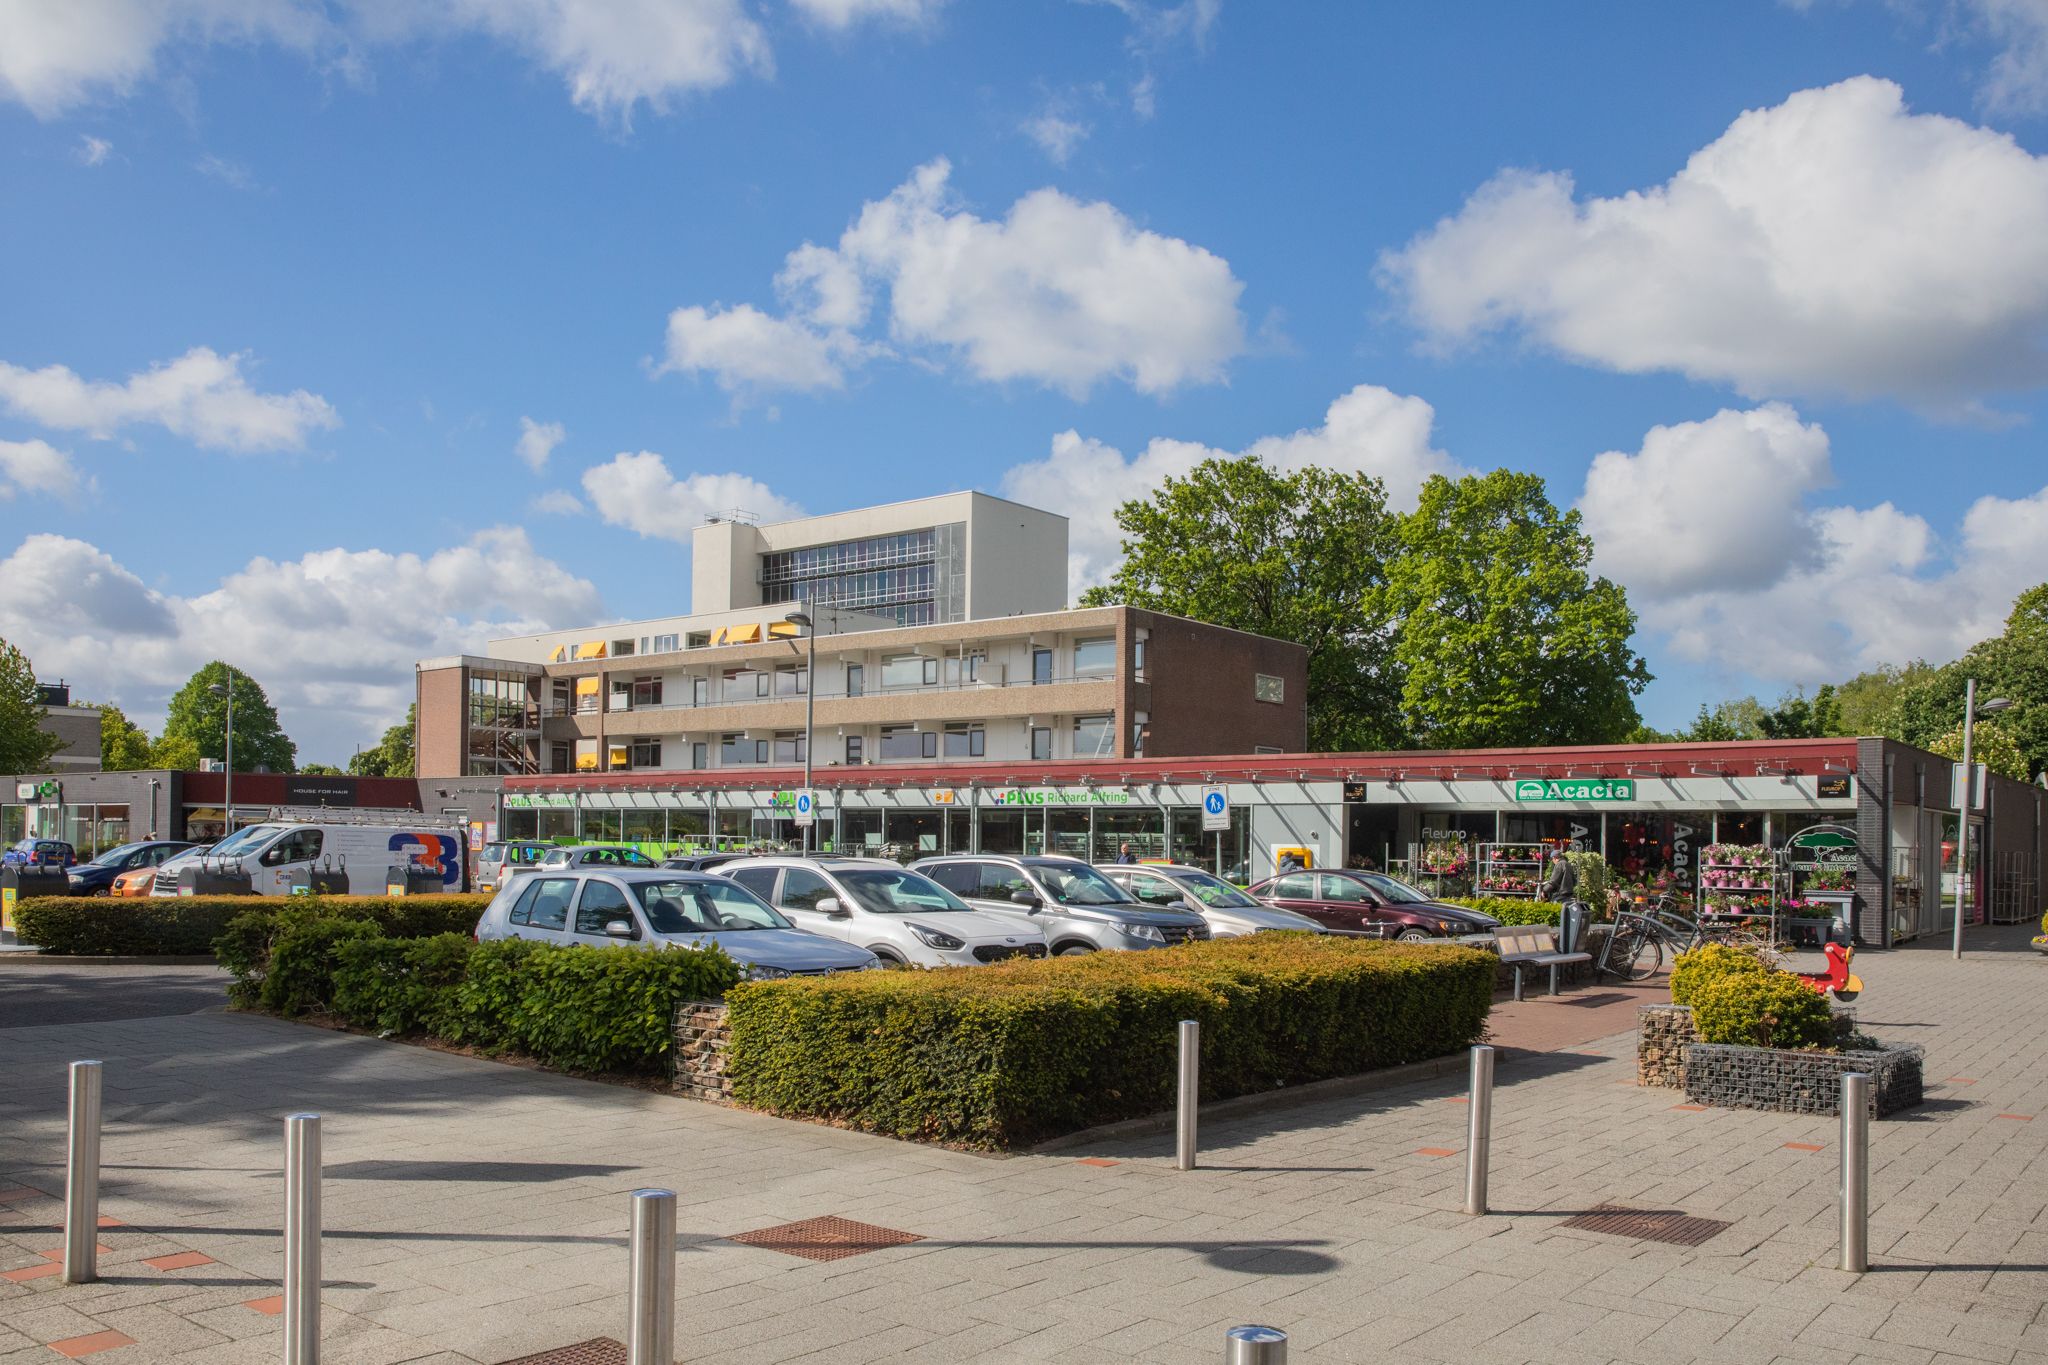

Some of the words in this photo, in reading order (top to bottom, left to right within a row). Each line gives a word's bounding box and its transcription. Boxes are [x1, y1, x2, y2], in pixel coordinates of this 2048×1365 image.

[1546, 782, 1629, 798] Acacia
[511, 797, 532, 807] PLUS
[1006, 791, 1045, 804] PLUS
[1047, 791, 1086, 803] Richard
[1091, 791, 1128, 803] Alfring
